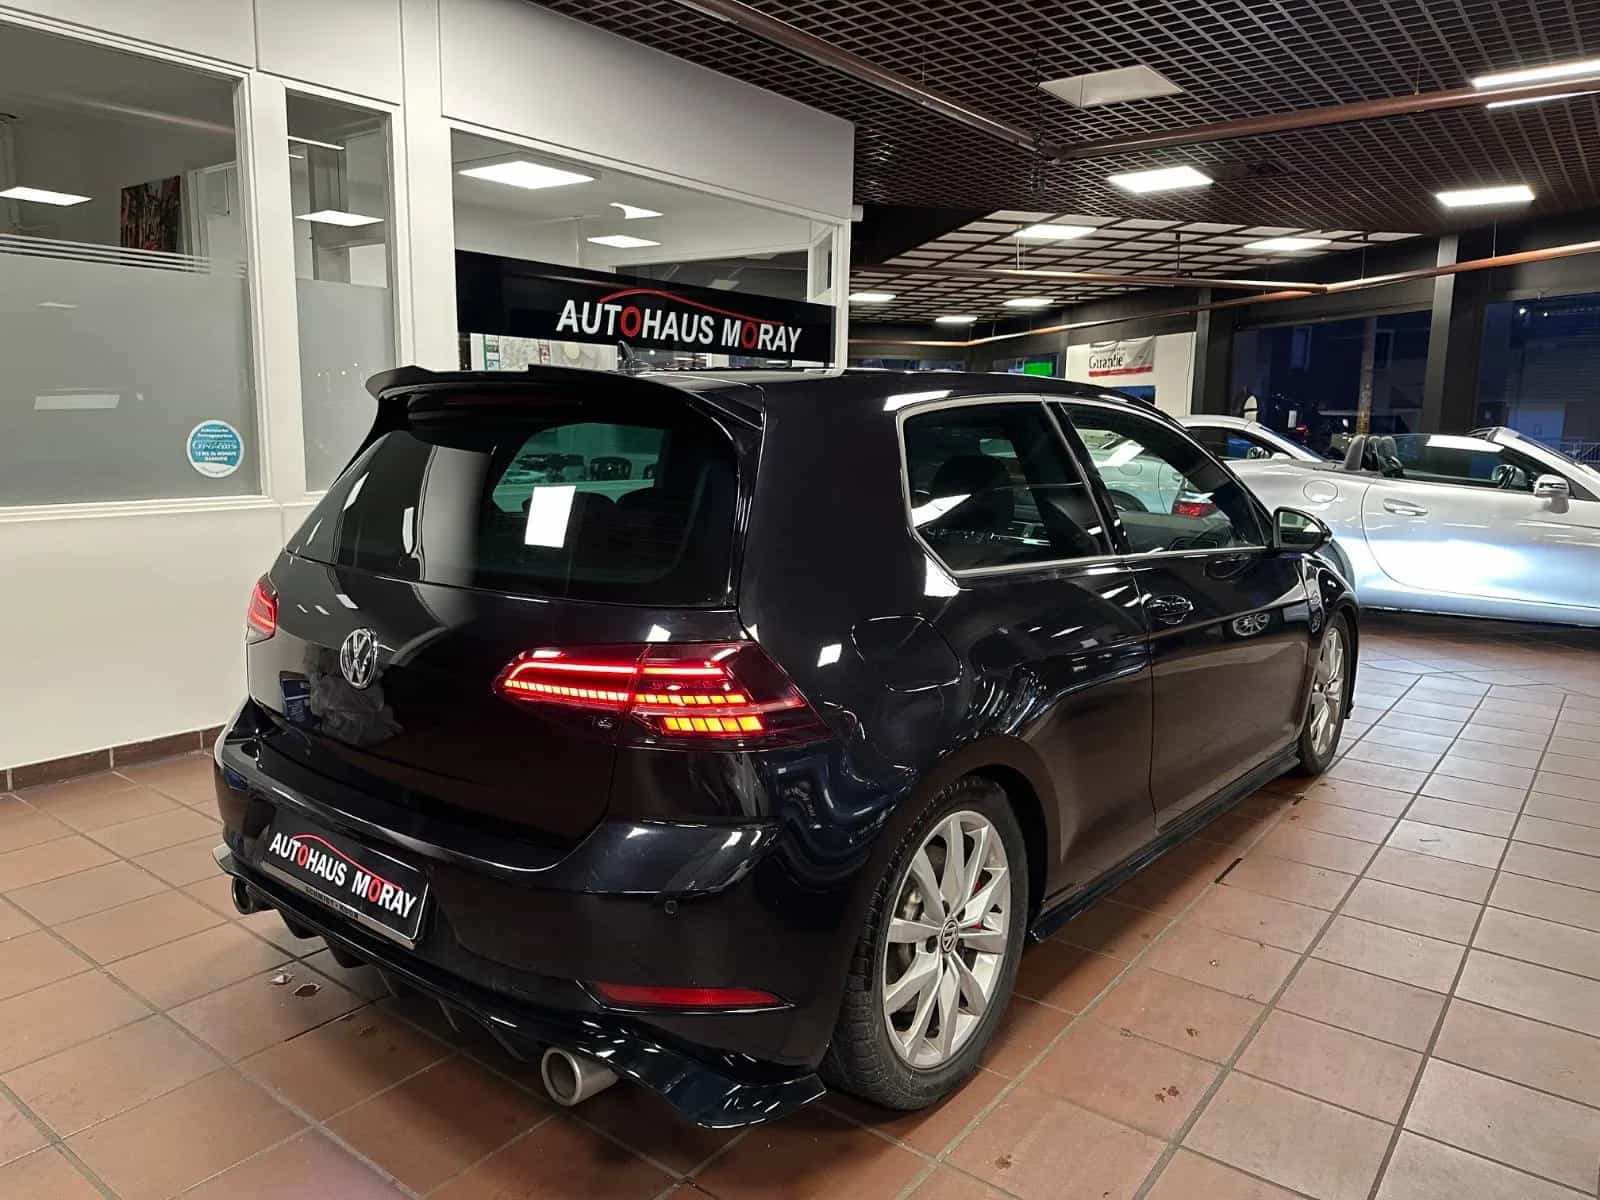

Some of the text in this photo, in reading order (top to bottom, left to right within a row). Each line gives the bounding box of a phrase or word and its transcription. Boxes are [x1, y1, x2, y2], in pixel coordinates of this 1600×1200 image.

[555, 299, 802, 353] AUTOHAUS MORAY
[268, 832, 417, 919] AUTOHAUS MORAY
